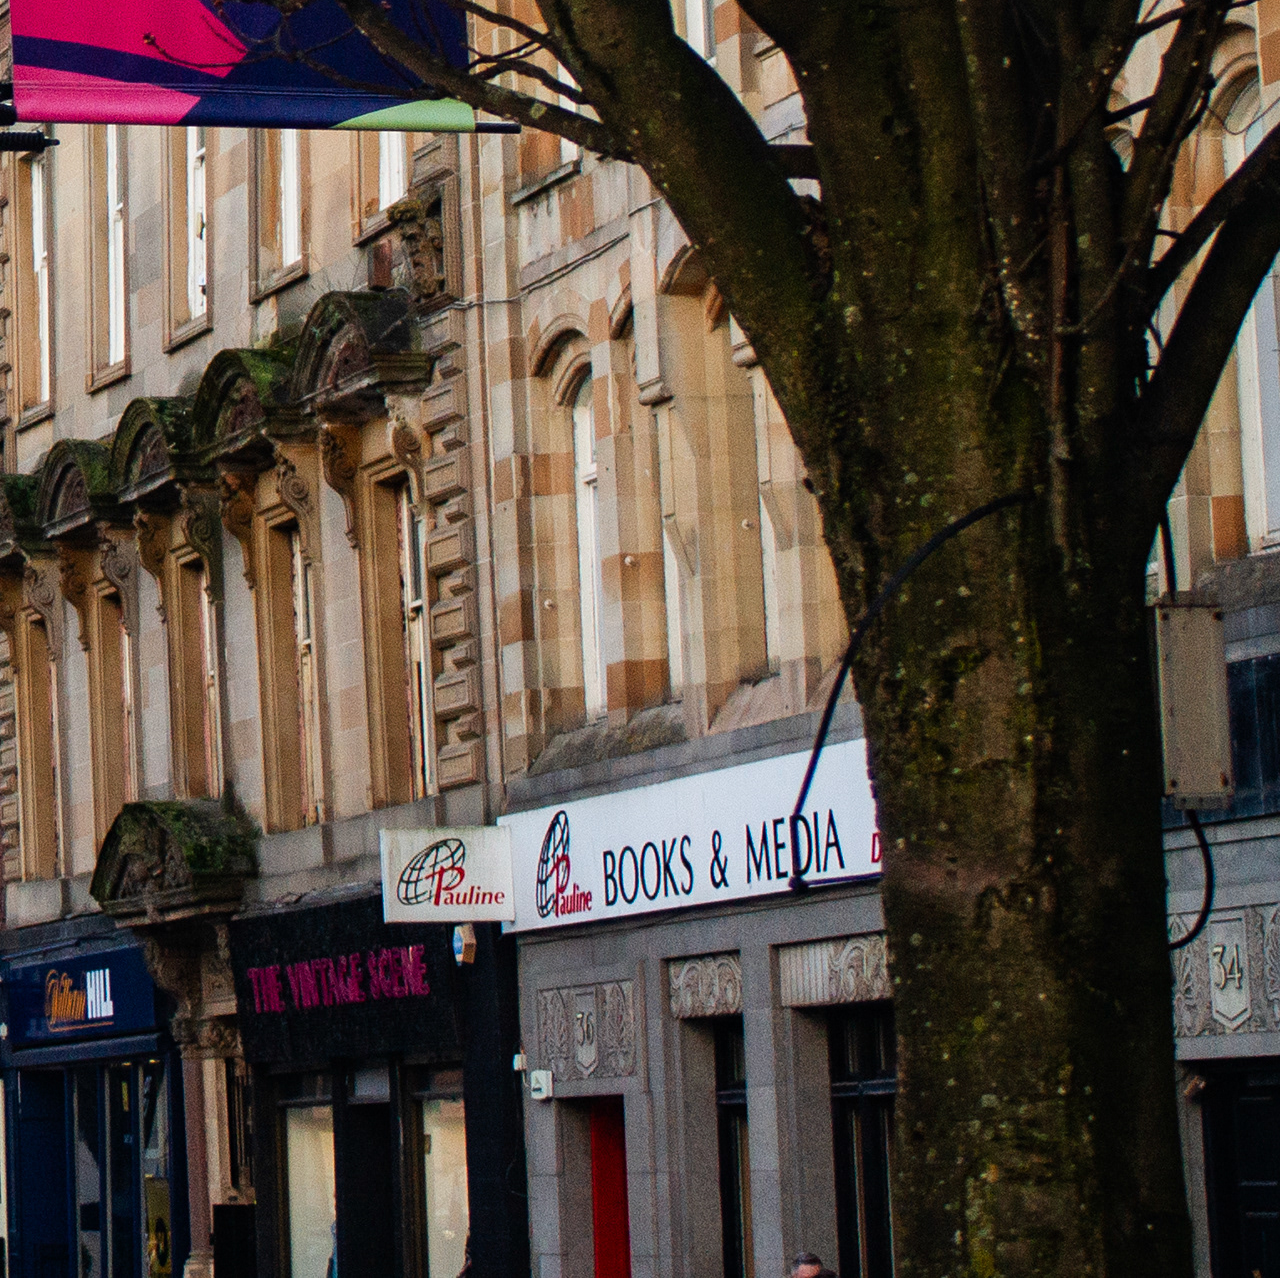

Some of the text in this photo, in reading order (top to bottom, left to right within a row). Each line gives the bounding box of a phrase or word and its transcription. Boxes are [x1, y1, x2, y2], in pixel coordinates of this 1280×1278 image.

[602, 834, 695, 907] BOOKS
[709, 829, 730, 890] &
[745, 808, 846, 884] MEDIA
[424, 865, 506, 907] Pauline
[550, 854, 593, 918] Pauline
[246, 943, 431, 1015] THE VINTAGE SCENE
[1211, 942, 1244, 991] 34
[86, 967, 114, 1020] HILL
[575, 1011, 594, 1047] 36
